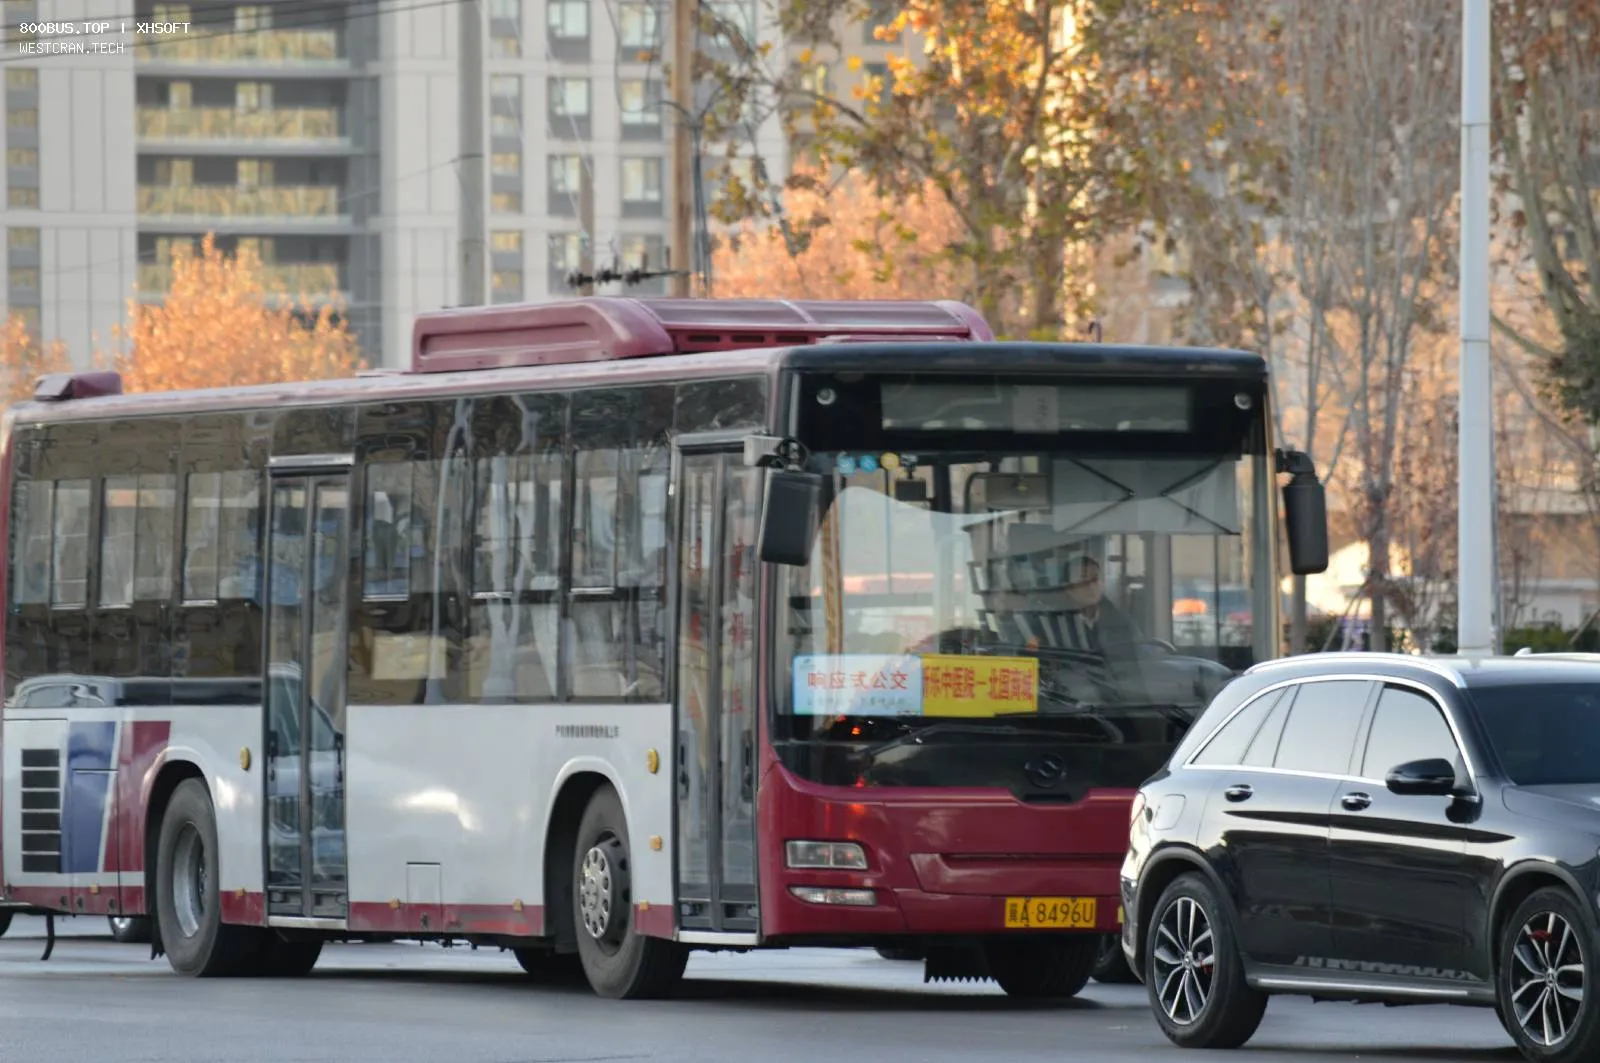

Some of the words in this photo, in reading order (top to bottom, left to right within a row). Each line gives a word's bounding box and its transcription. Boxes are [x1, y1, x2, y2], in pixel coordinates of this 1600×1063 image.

[807, 670, 909, 690] 响应式公交
